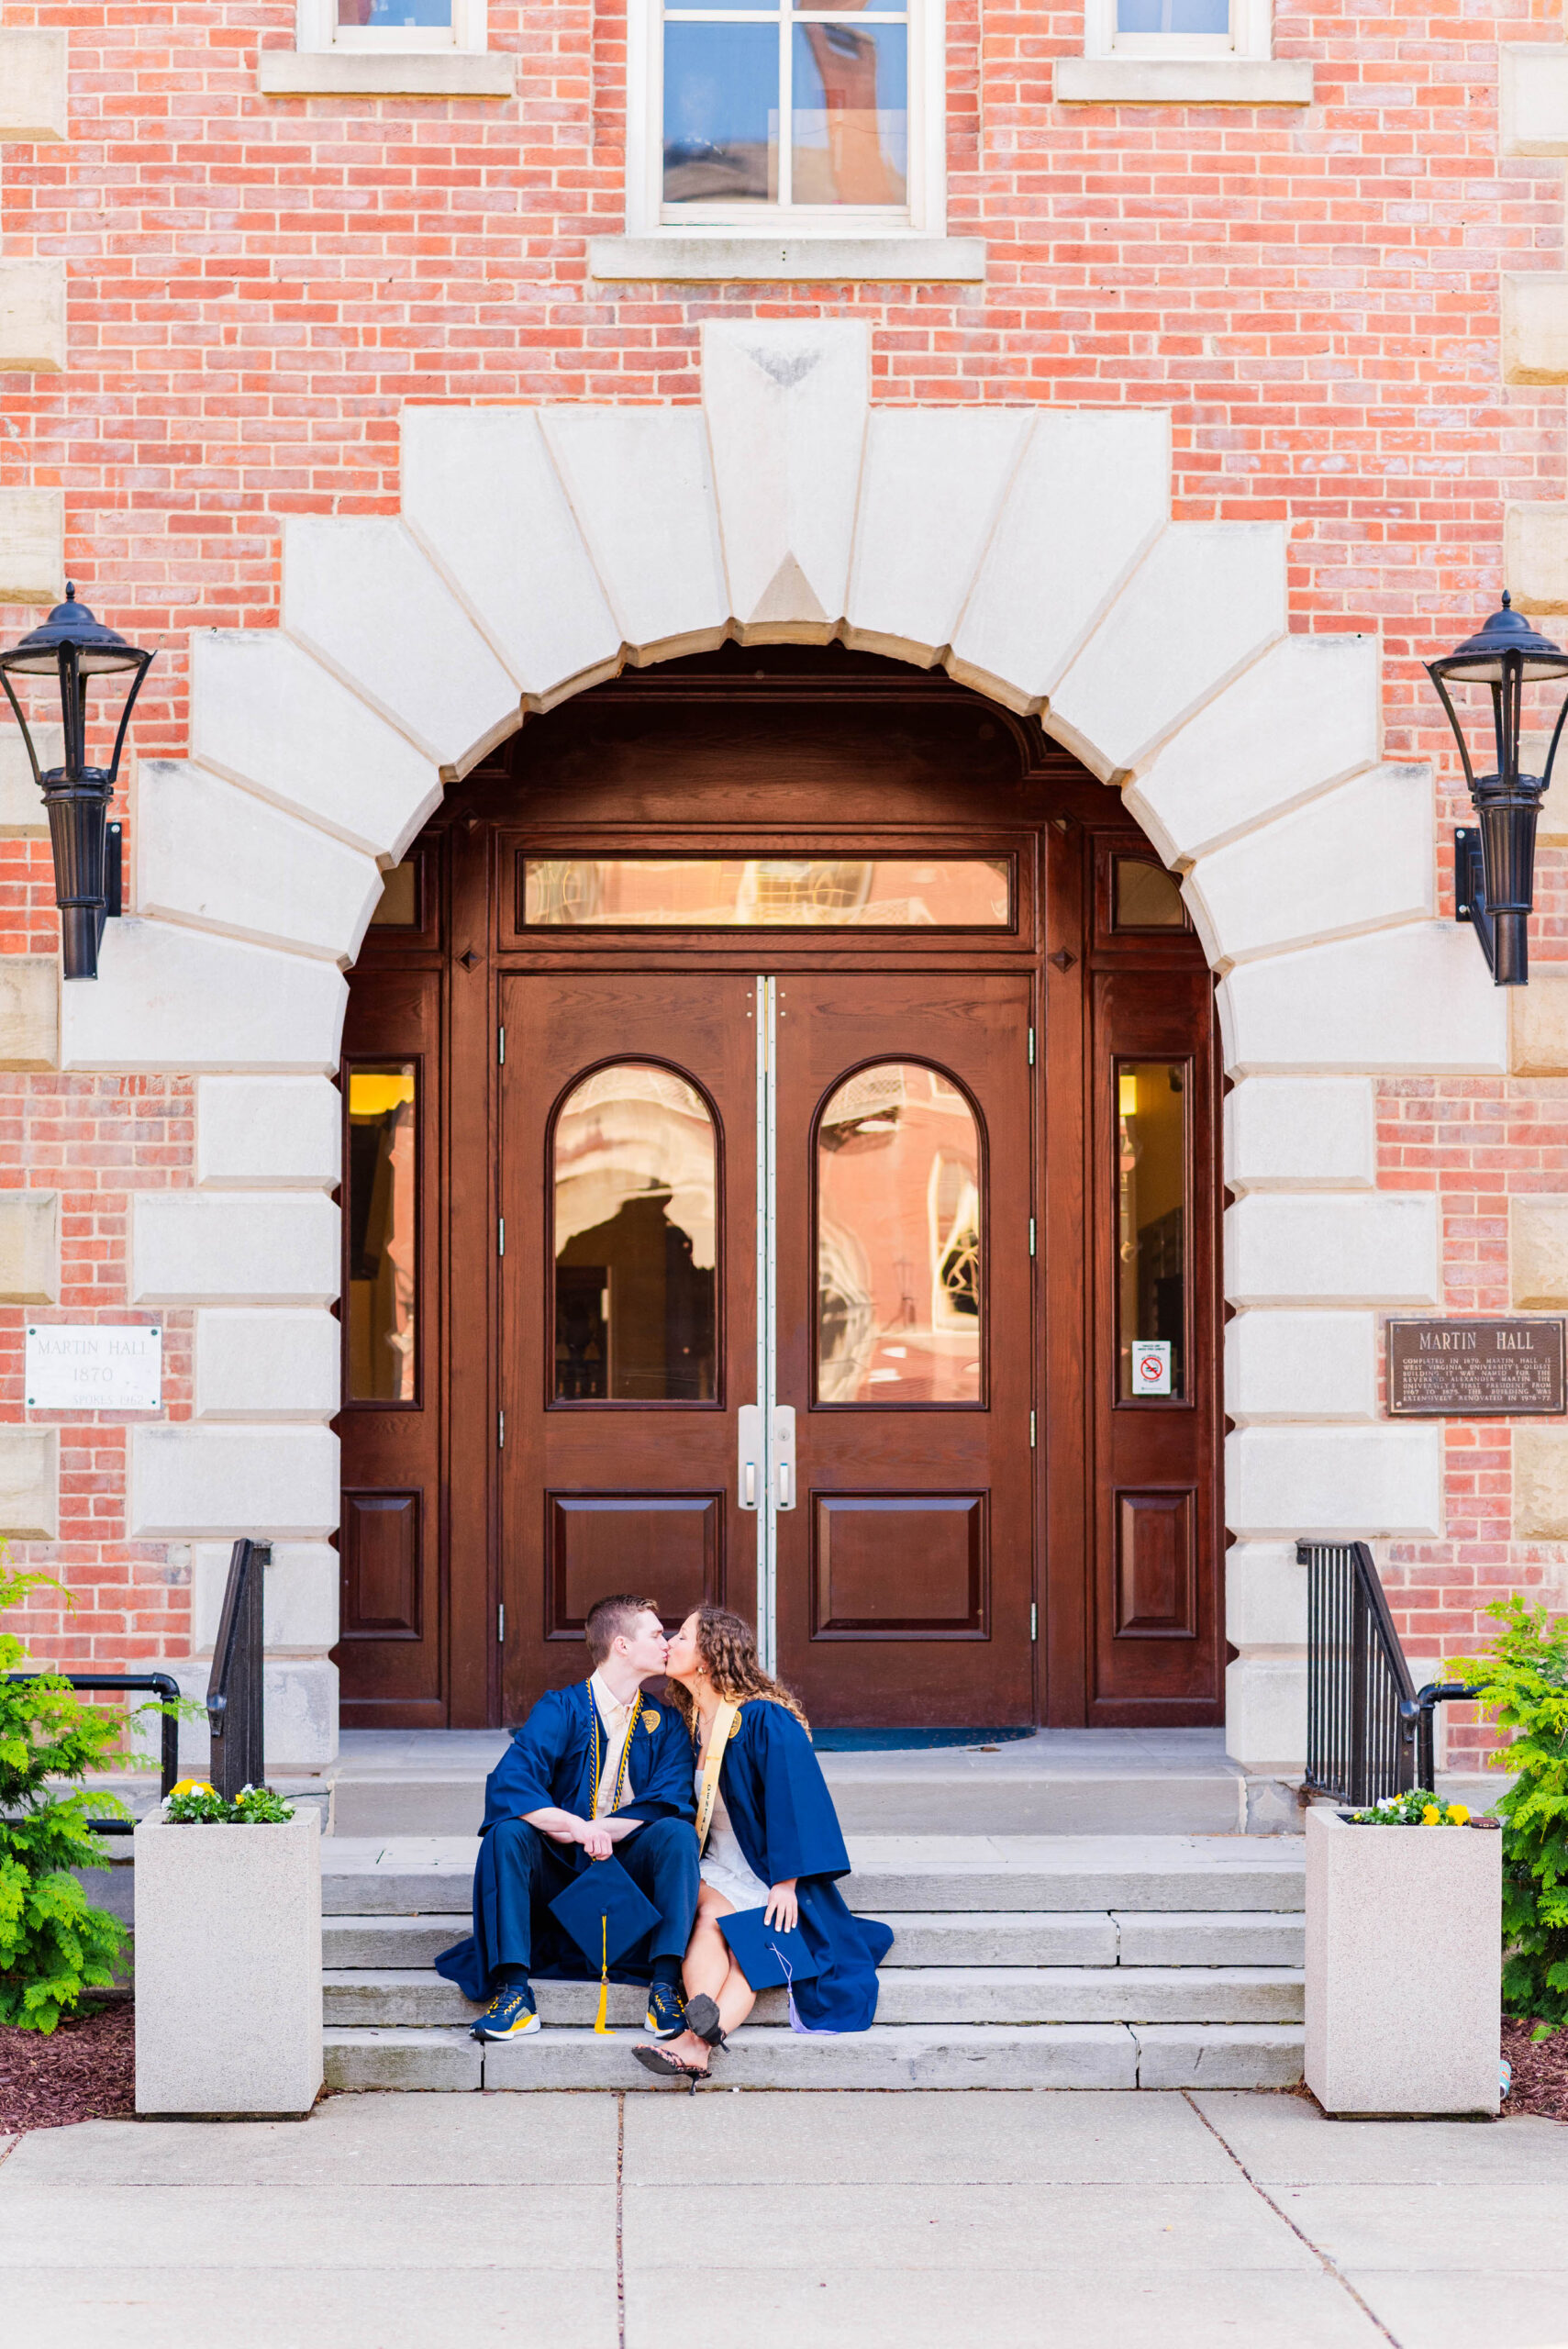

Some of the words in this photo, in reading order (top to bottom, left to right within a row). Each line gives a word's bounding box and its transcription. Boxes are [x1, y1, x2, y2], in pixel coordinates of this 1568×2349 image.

[38, 1340, 99, 1355] MARTIN
[109, 1340, 148, 1355] HALL
[1419, 1331, 1476, 1351] MARTIN
[1496, 1331, 1534, 1350] HALL
[73, 1366, 114, 1382] 1870
